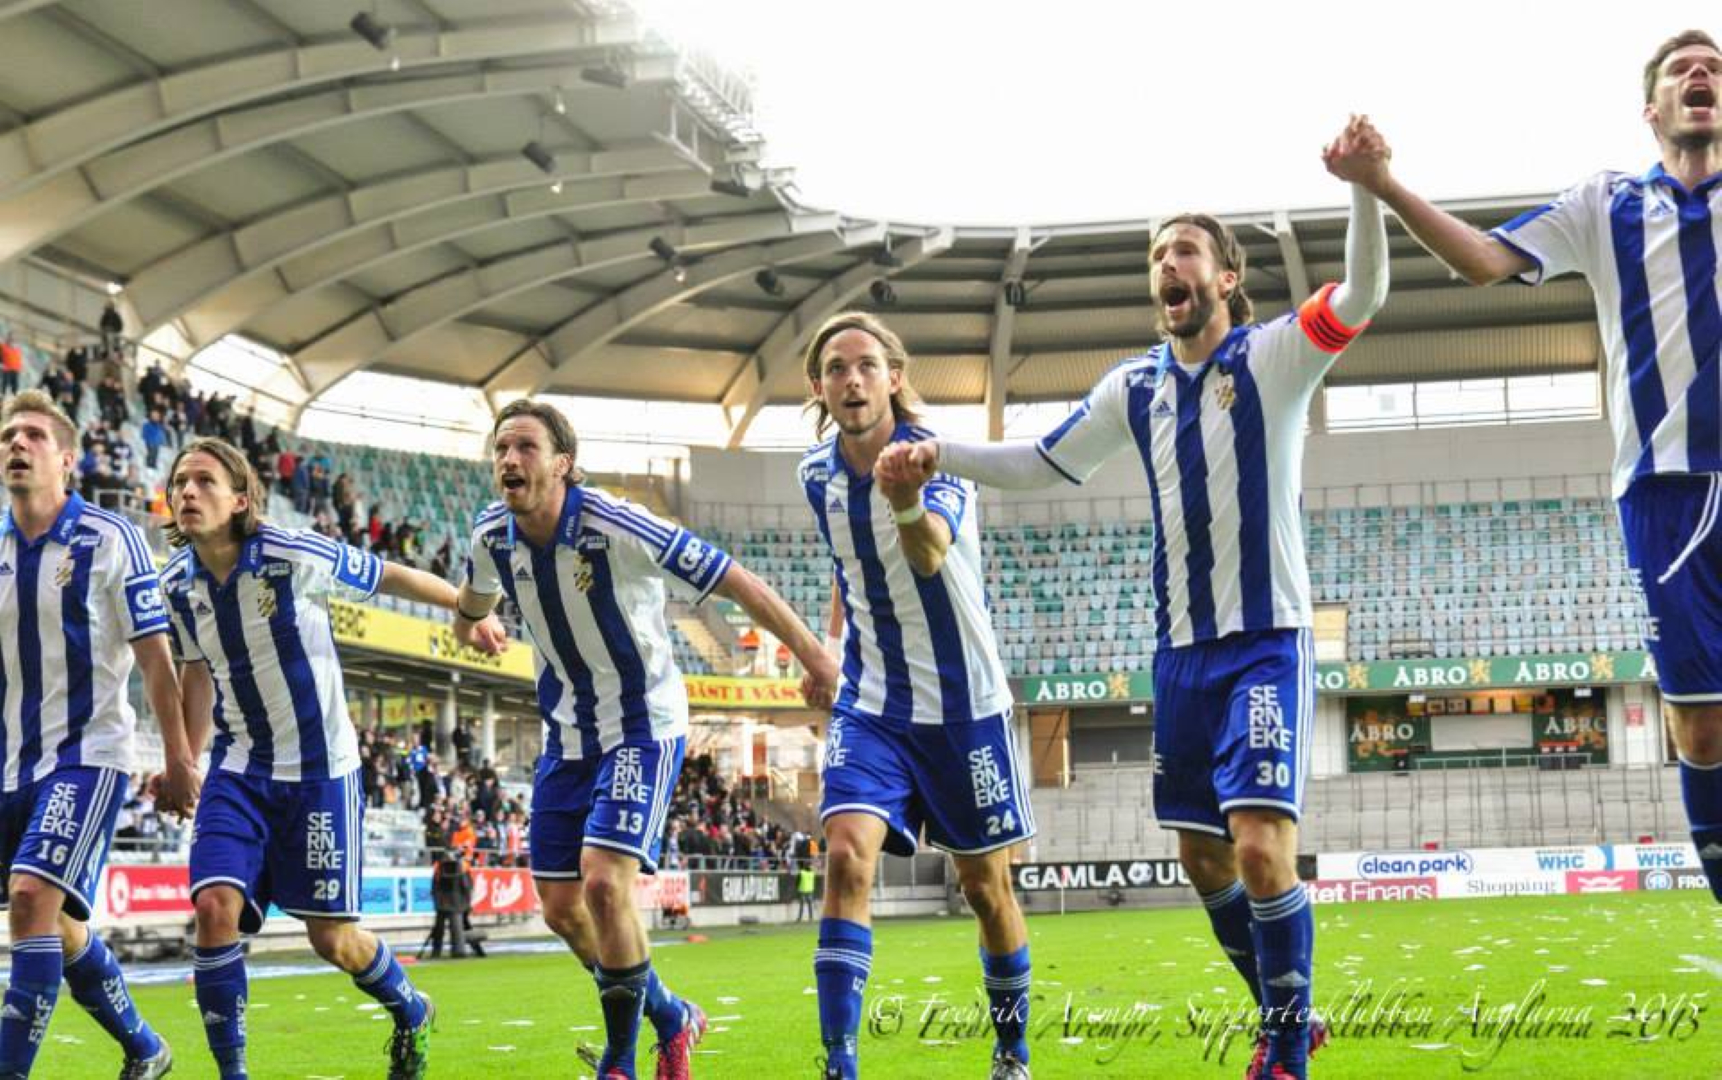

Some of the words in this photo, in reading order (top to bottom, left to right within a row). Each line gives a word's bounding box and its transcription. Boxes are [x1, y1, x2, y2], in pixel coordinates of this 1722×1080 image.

[1249, 685, 1278, 706] SE
[1250, 706, 1283, 727] RN
[1250, 728, 1293, 752] EKE
[614, 747, 641, 765] SE
[968, 745, 994, 770] SE
[614, 765, 643, 783] RN
[972, 763, 1000, 790] RN
[1256, 760, 1290, 788] 30
[51, 782, 79, 801] SE
[611, 783, 652, 804] EKE
[975, 780, 1010, 809] EKE
[46, 800, 76, 820] RN
[40, 815, 80, 840] EKE
[307, 812, 333, 831] SE
[616, 809, 644, 835] 13
[987, 809, 1016, 836] 24
[307, 831, 335, 850] RN
[37, 840, 69, 865] 16
[306, 850, 344, 869] EKE
[1537, 855, 1585, 870] WHC
[1637, 853, 1685, 867] WHC
[1362, 856, 1415, 874] clean
[1419, 854, 1468, 876] park
[1018, 863, 1127, 889] GAMLA
[313, 879, 340, 900] 29
[1351, 881, 1433, 903] Finans
